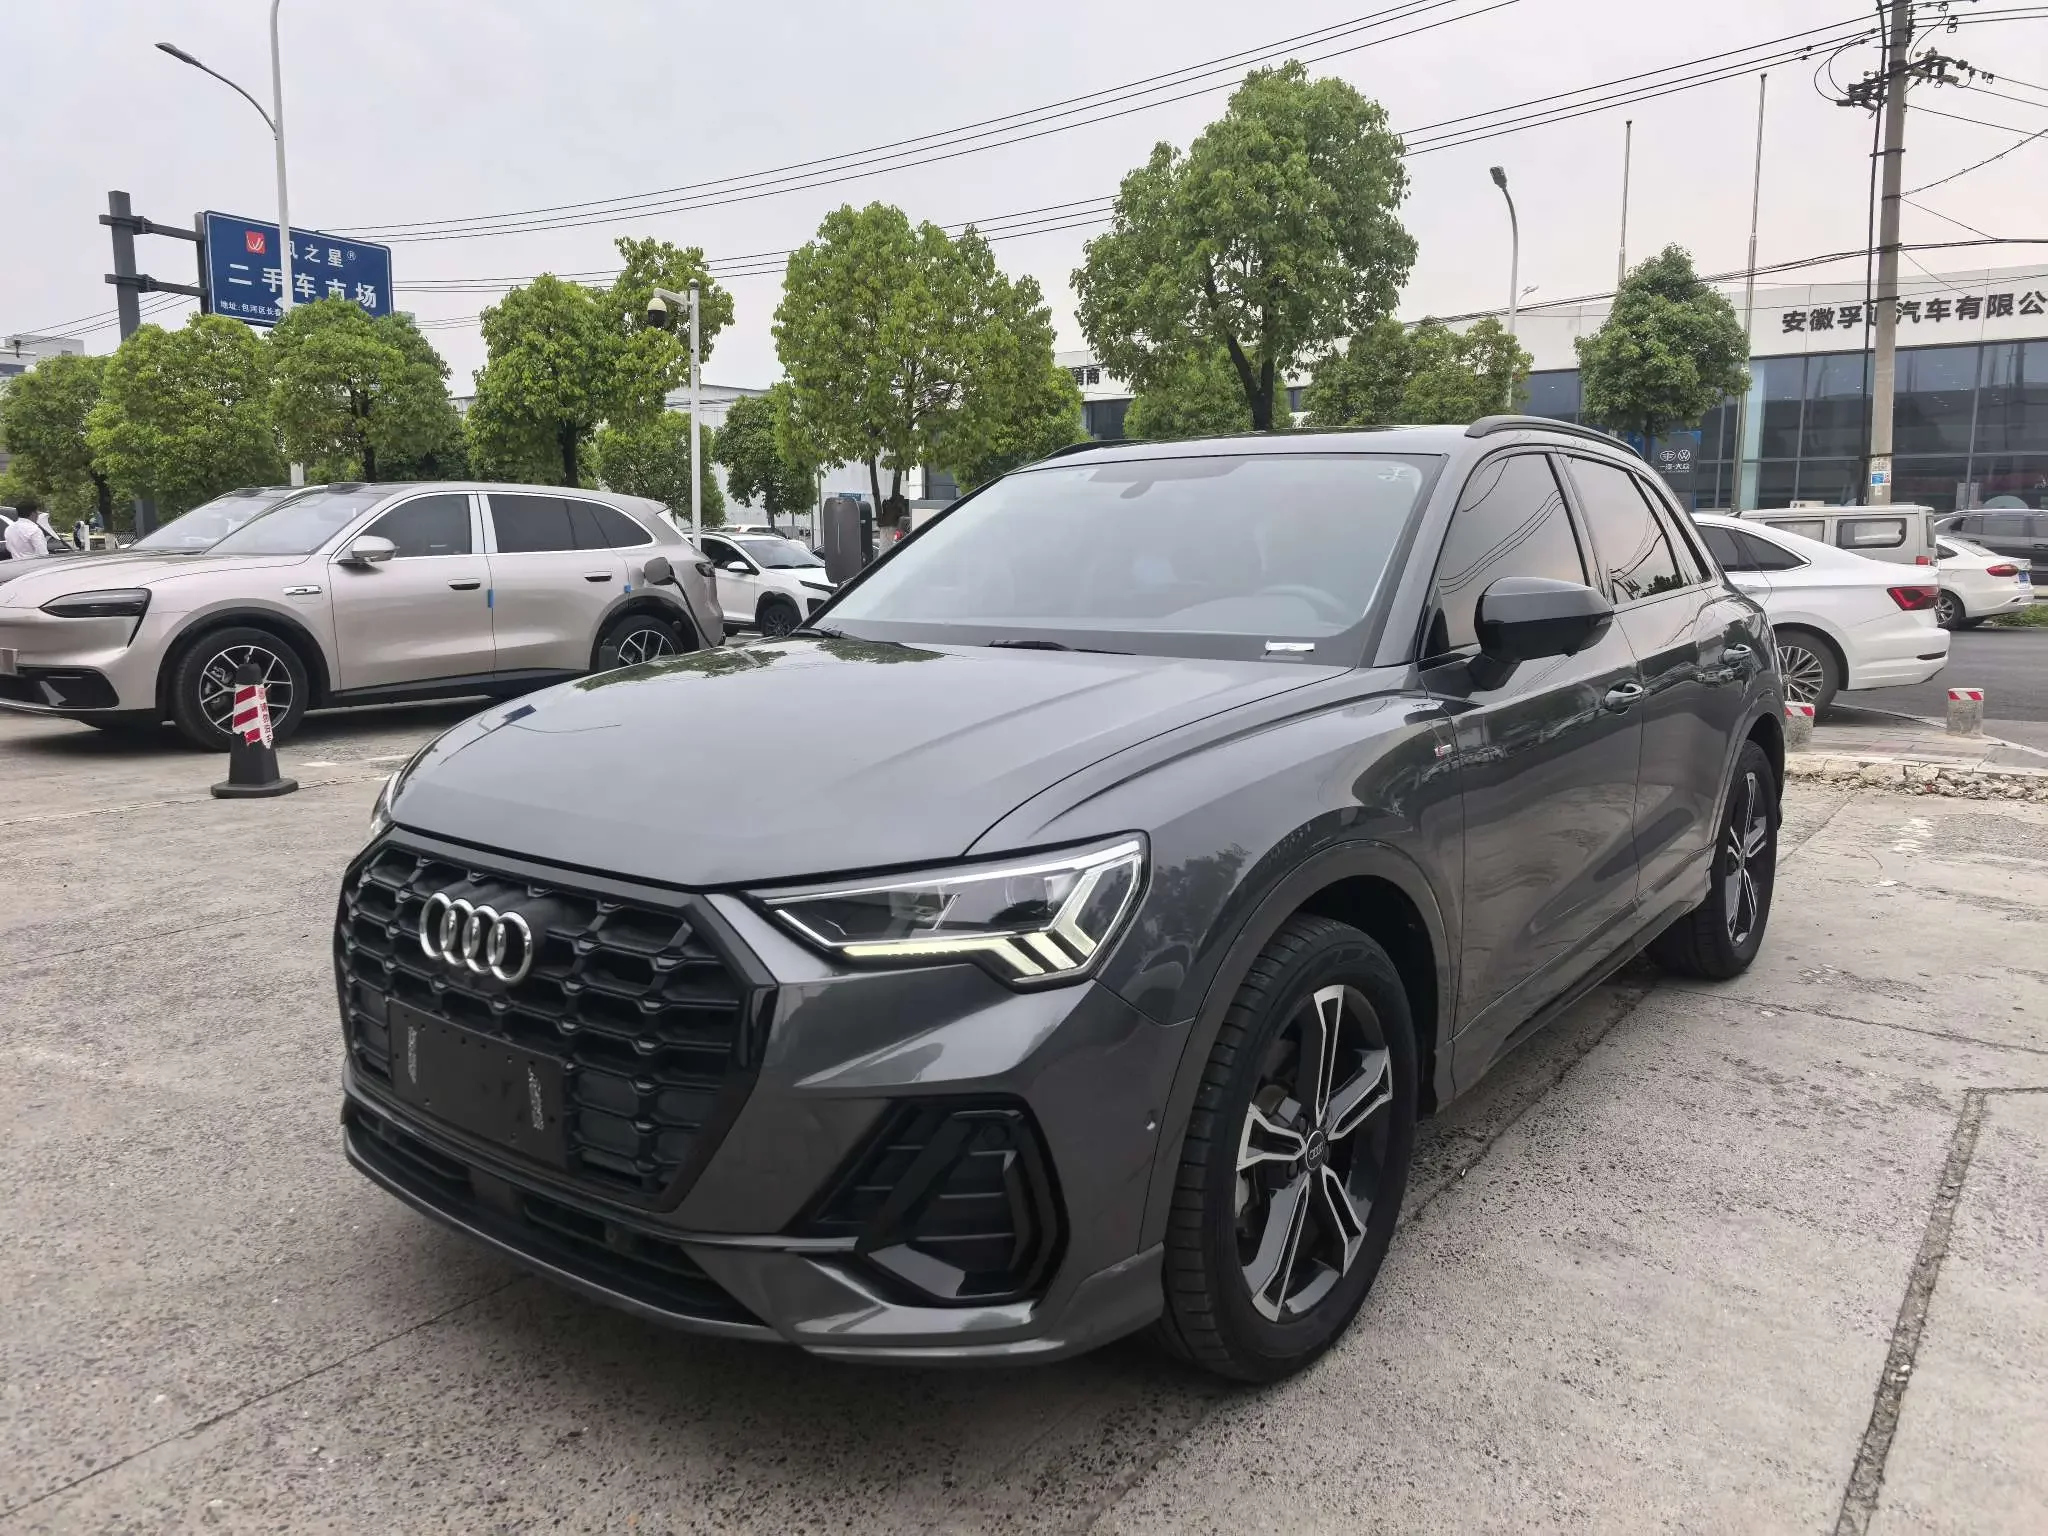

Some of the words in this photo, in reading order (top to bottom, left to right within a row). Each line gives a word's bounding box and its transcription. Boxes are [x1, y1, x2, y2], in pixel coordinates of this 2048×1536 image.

[228, 263, 377, 309] 二手车市场
[1782, 290, 2048, 333] 安徽孚汽车有限公
